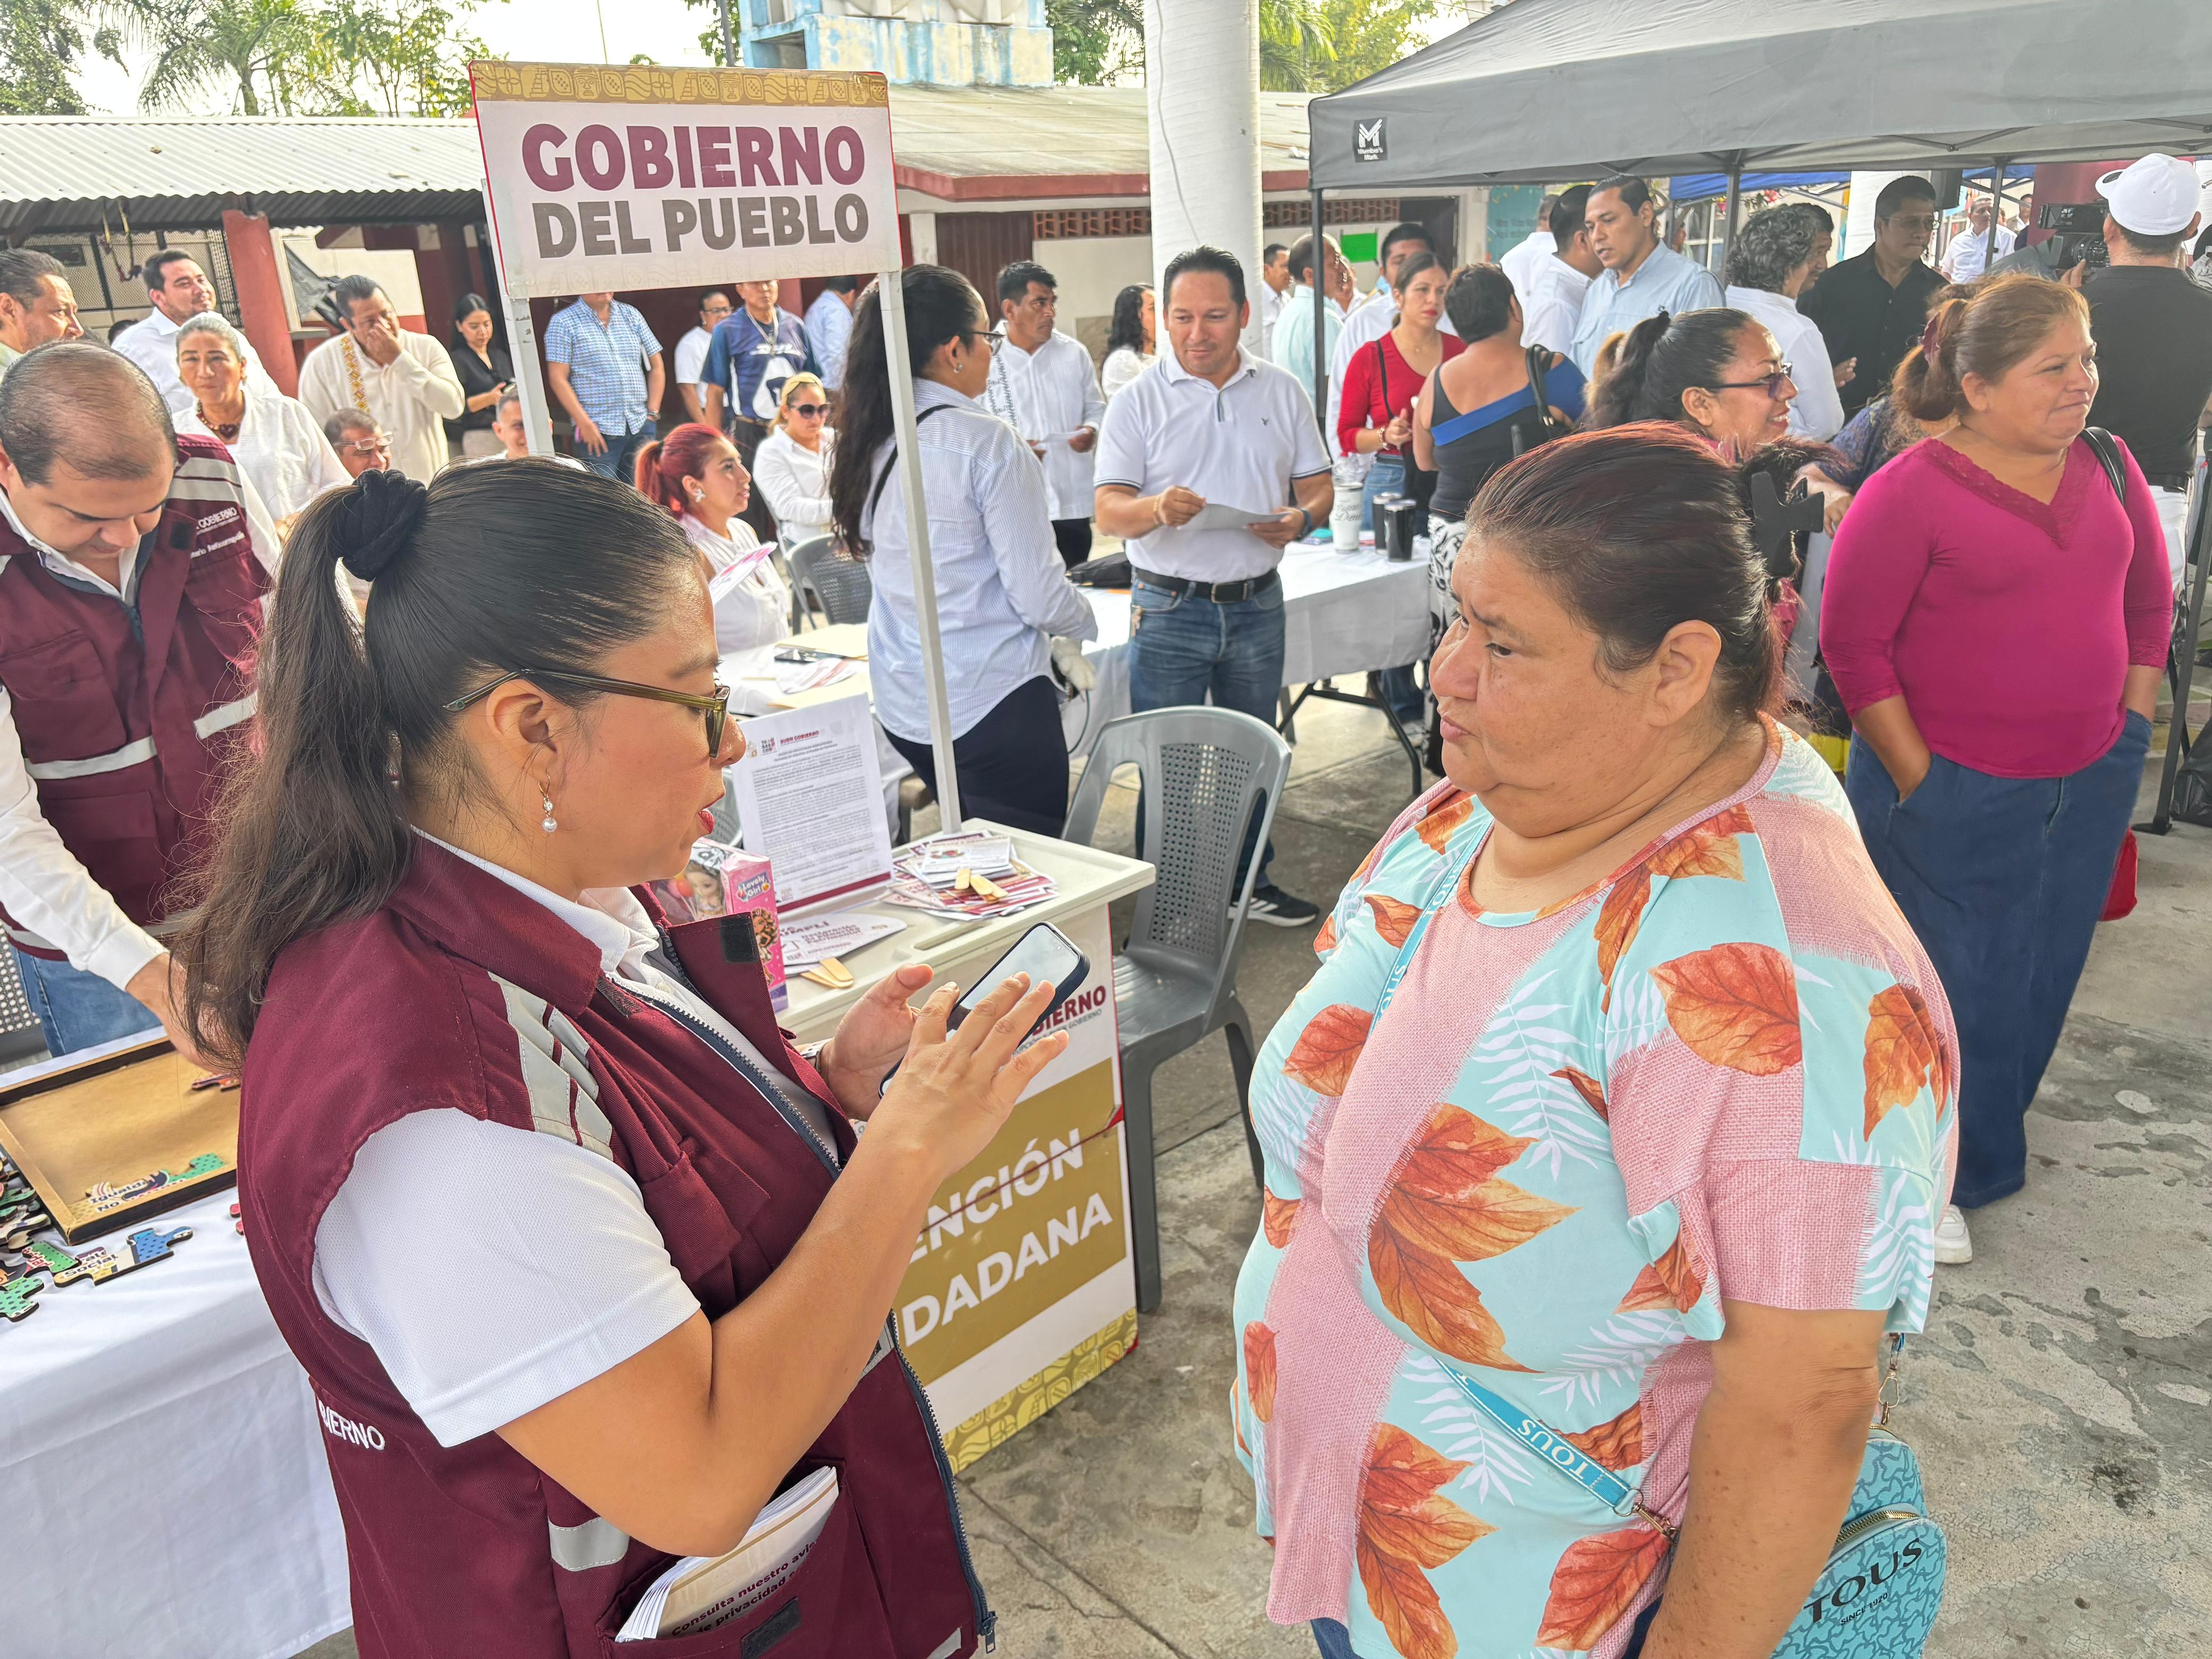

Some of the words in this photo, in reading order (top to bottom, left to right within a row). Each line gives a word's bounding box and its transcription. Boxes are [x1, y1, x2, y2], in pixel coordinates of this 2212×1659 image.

[522, 123, 865, 192] GOBIERNO
[532, 200, 652, 259] DEL
[662, 193, 868, 253] PUEBLO
[198, 507, 238, 528] GOBIERNO
[743, 875, 766, 890] Lovely
[748, 885, 761, 897] Girl
[97, 1201, 120, 1212] No
[64, 1254, 118, 1277] Social
[901, 1193, 1113, 1347] DADANA
[1517, 1419, 1591, 1479] TOUS
[672, 1596, 735, 1637] Consulta
[738, 1563, 789, 1598] nuestro
[716, 1577, 786, 1627] privacidad
[1803, 1537, 1922, 1624] TOUS
[1840, 1605, 1867, 1626] SINCE
[1869, 1592, 1888, 1608] 1920
